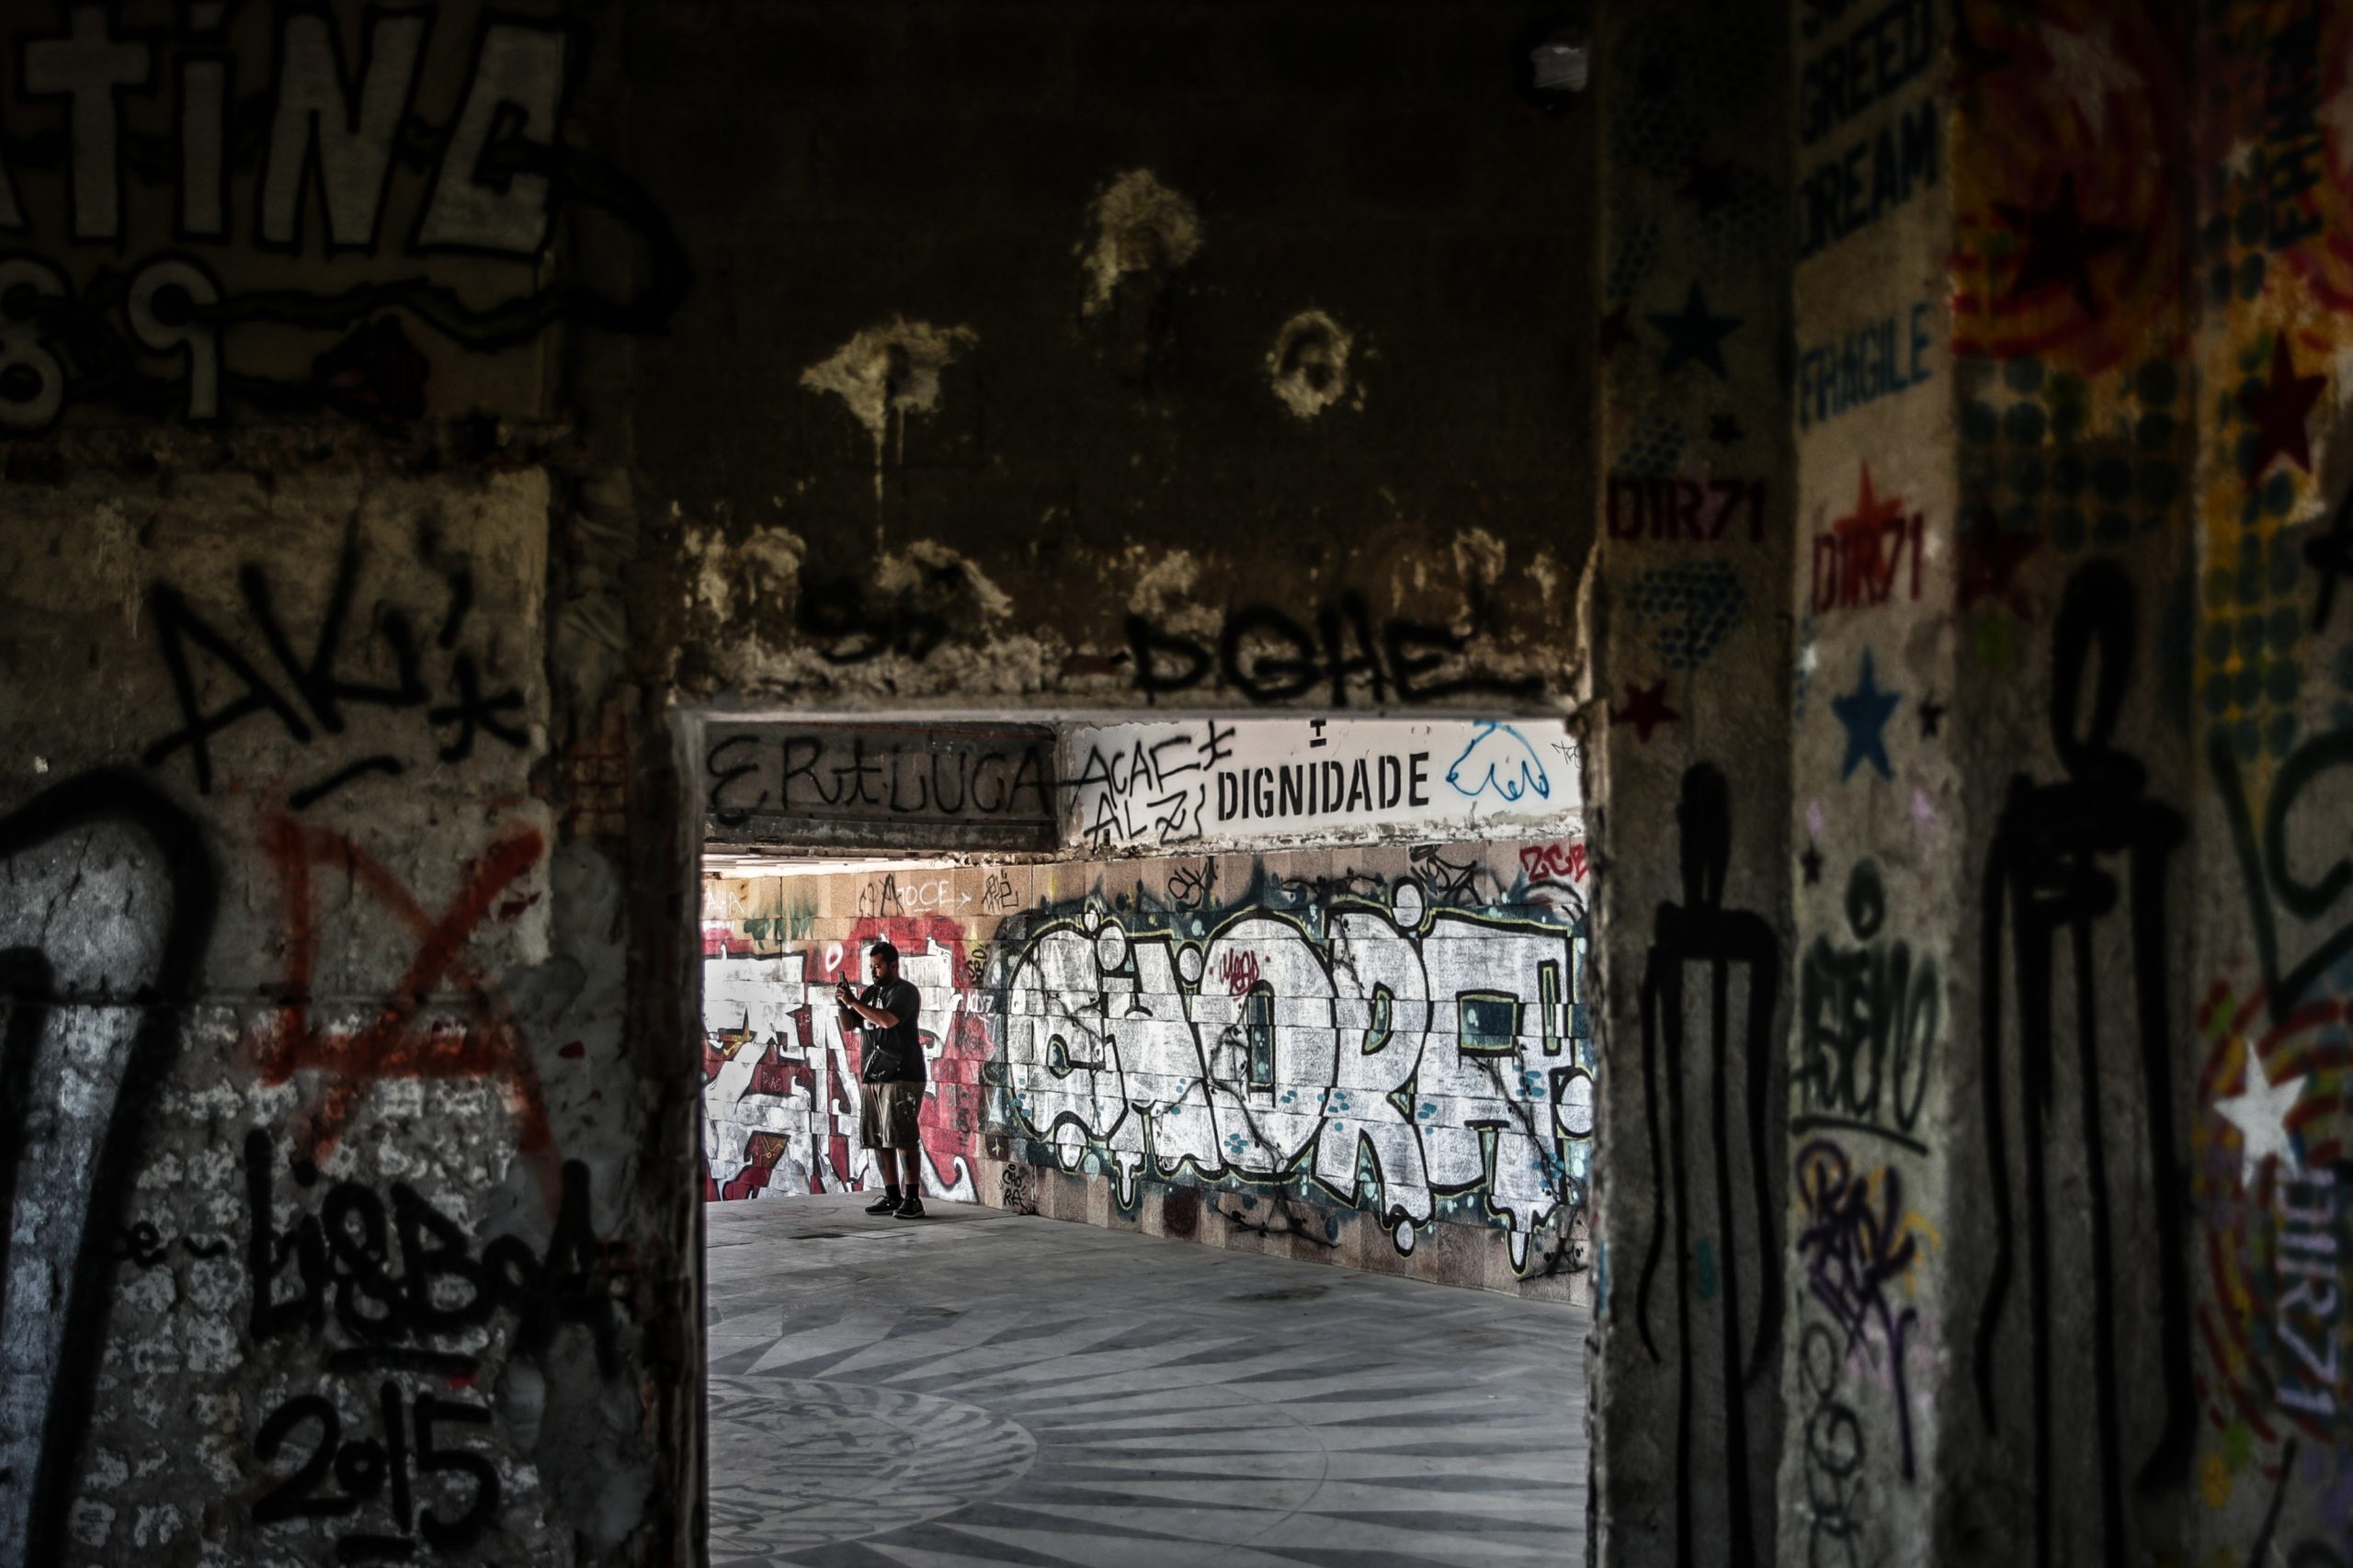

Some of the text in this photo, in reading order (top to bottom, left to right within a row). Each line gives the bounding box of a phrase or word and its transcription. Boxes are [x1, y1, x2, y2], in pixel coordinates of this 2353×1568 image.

[1799, 301, 1932, 429] FRAGILE
[1217, 751, 1430, 822] DIGNIDADE
[251, 1381, 501, 1555] 2015
